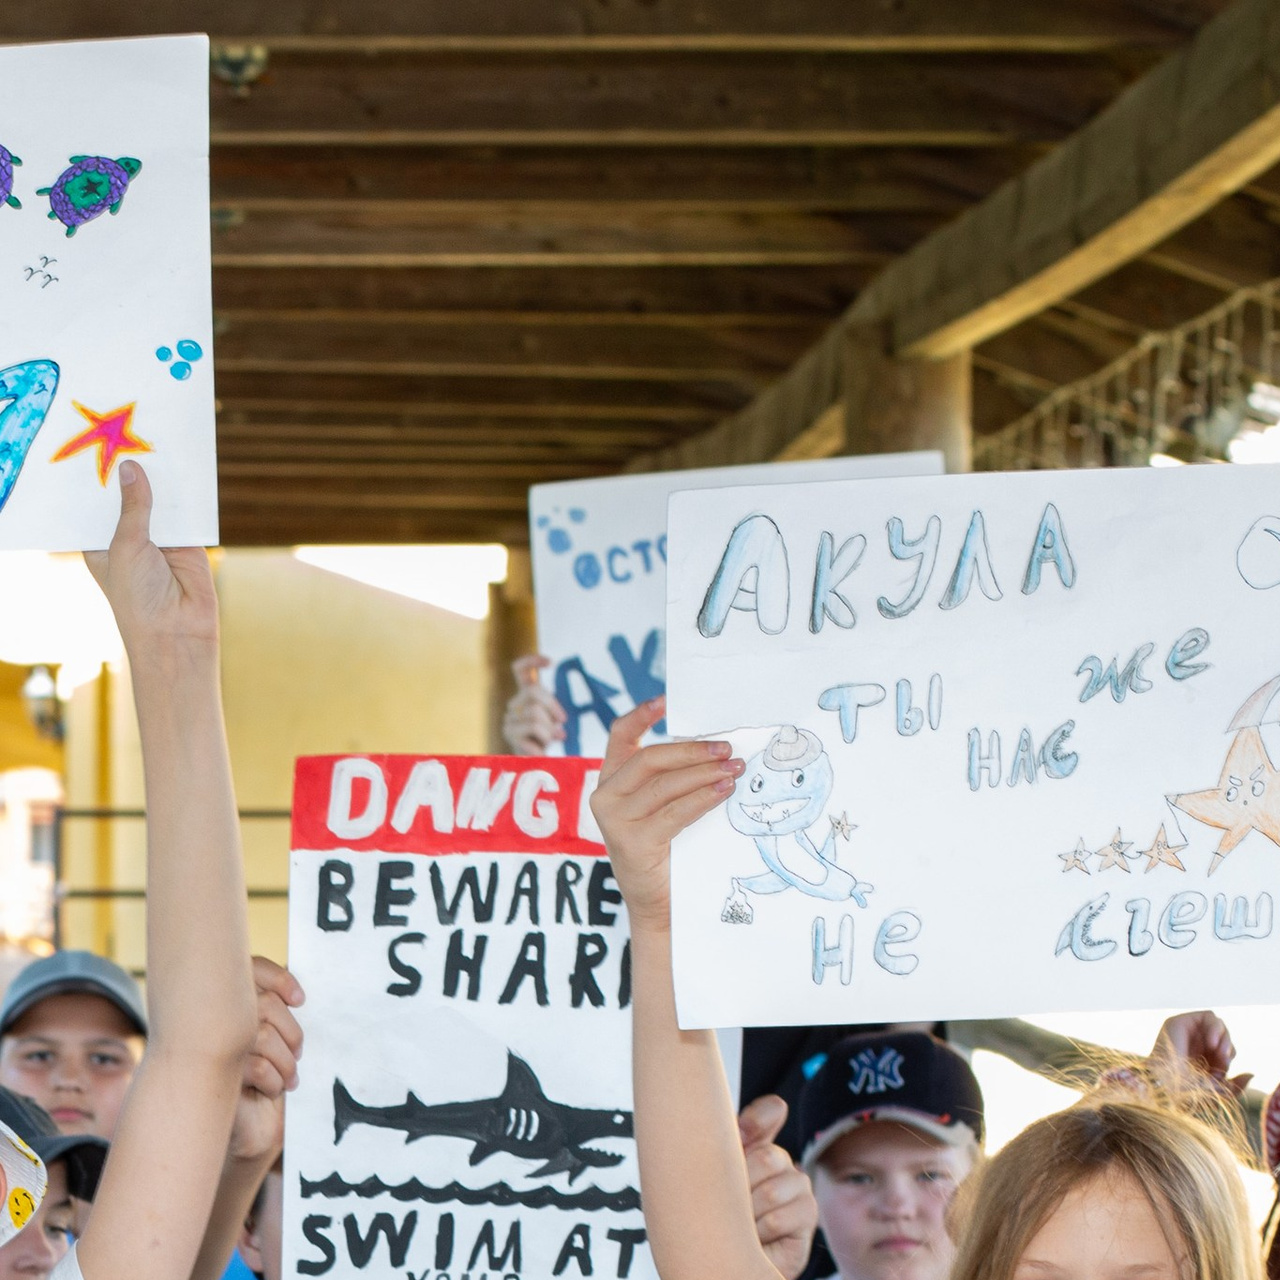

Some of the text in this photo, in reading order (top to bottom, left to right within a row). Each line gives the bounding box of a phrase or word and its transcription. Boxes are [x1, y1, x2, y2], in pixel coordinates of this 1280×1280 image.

[696, 502, 1077, 638] АКУЛА
[316, 857, 623, 932] BEWARE
[296, 1210, 648, 1280] SWIM AT
